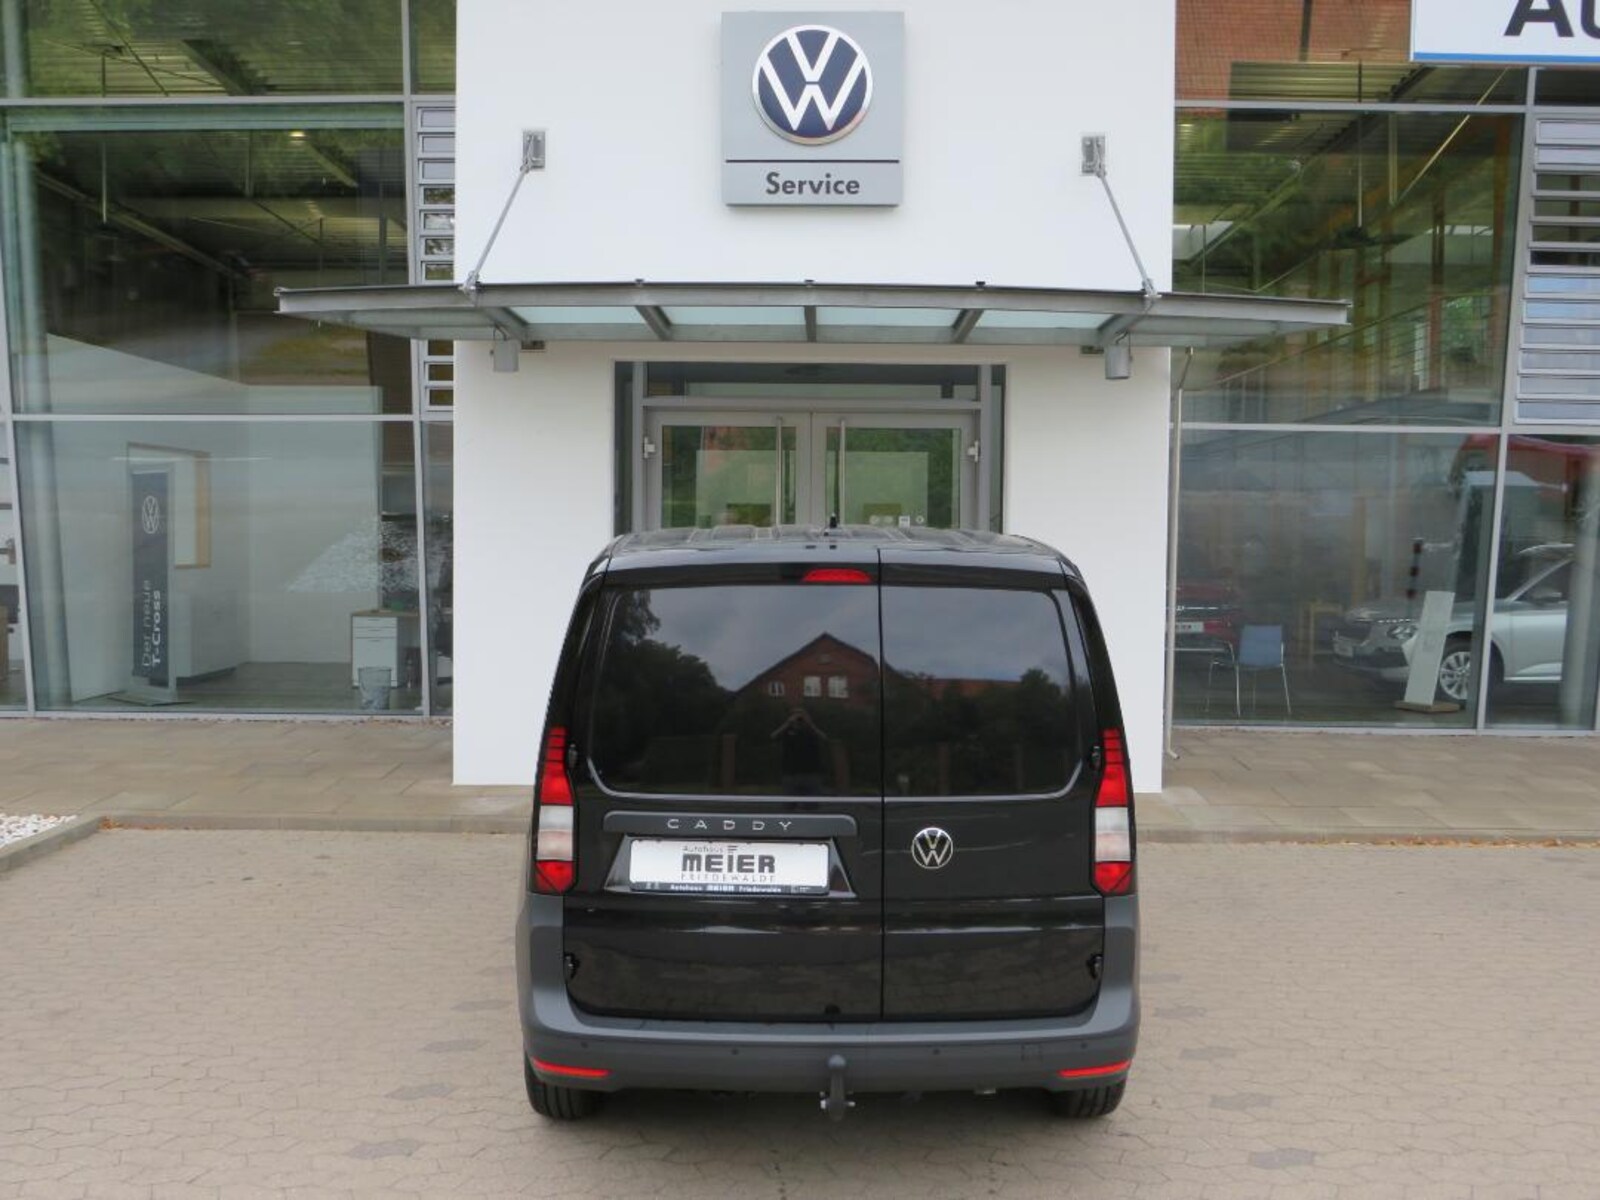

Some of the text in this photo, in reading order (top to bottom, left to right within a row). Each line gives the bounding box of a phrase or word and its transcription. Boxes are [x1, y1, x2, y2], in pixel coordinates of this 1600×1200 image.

[1503, 0, 1600, 39] A
[765, 171, 860, 195] Service
[142, 580, 152, 667] Der neue
[151, 590, 161, 667] T-Cross
[667, 819, 792, 831] CADDY
[682, 845, 724, 853] Autohaus
